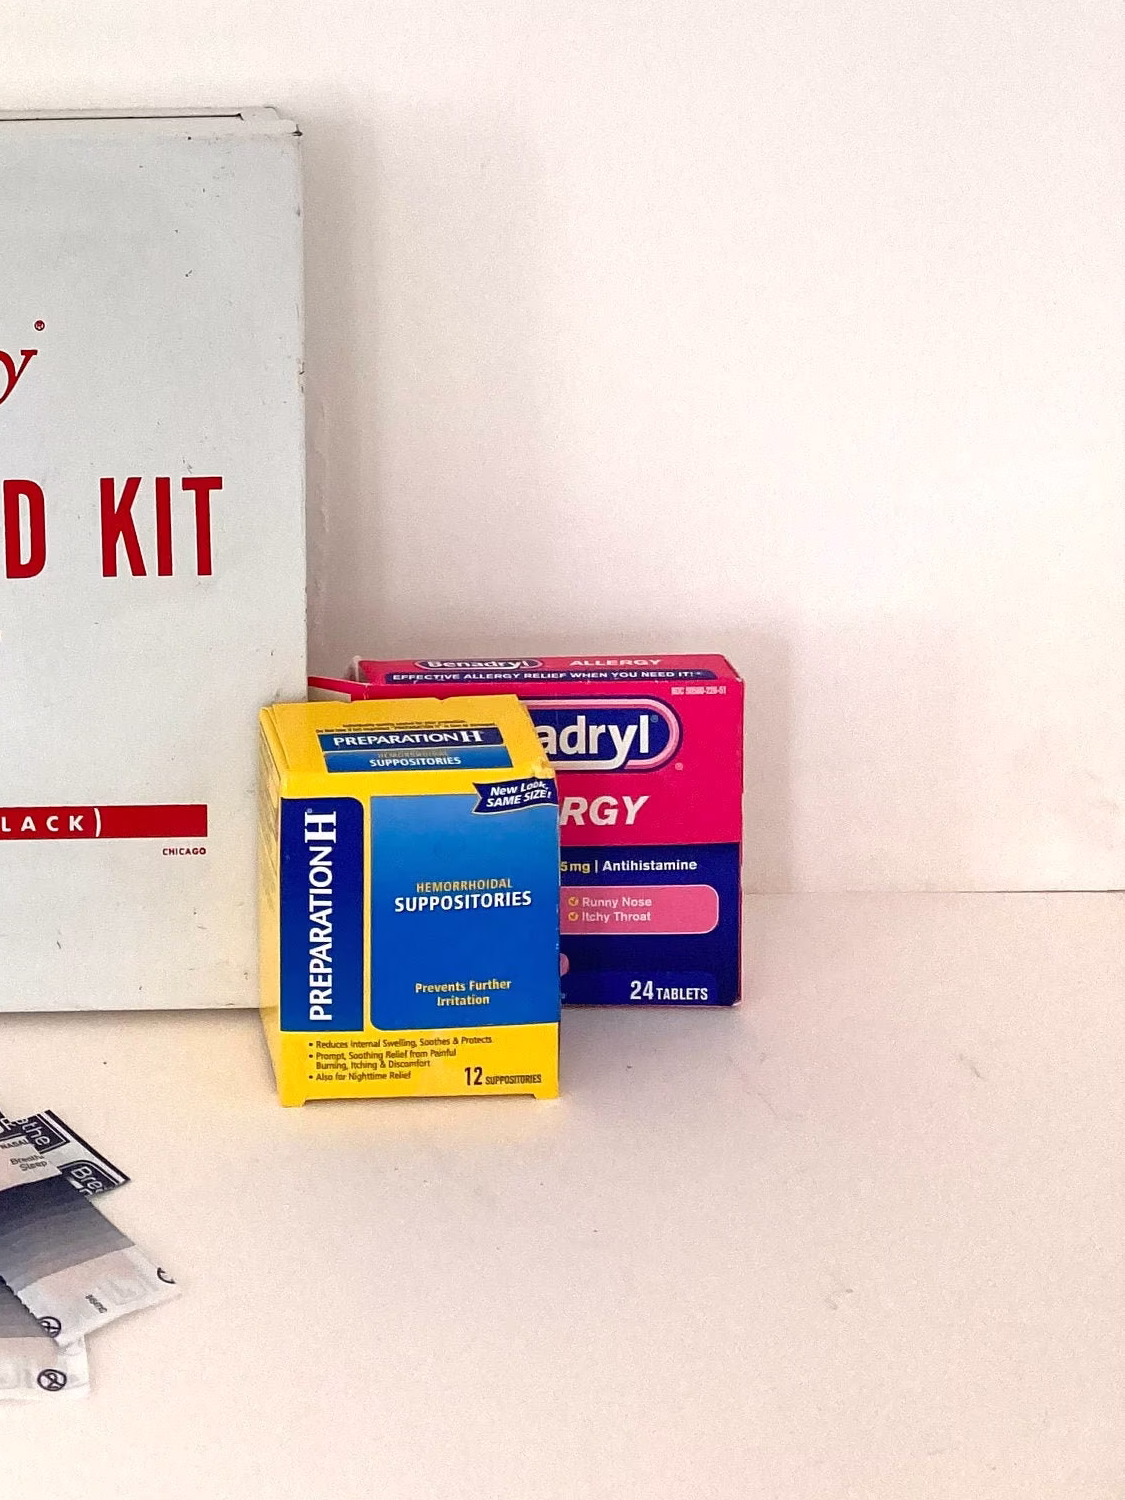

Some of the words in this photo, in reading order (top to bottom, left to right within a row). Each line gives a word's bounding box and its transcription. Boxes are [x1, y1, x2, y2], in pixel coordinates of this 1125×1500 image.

[99, 476, 223, 578] KIT
[427, 660, 530, 670] Benadryl
[569, 659, 662, 667] ALLERGY
[392, 673, 460, 681] EFFECTIVE
[463, 672, 520, 680] ALLERGY
[569, 671, 608, 679] WHEN
[369, 756, 462, 768] SUPPOSITORIES
[490, 785, 518, 797] New
[486, 795, 521, 808] SAME
[524, 788, 552, 803] SIZE!
[162, 847, 207, 856] CHICAGO
[602, 860, 698, 872] Antihistamine
[416, 878, 513, 893] HEMORRHOIDAL
[394, 890, 532, 913] SUPPOSITORIES
[582, 897, 618, 909] Runny
[622, 896, 652, 907] Nose
[582, 911, 610, 922] Itchy
[613, 911, 651, 921] Throat
[415, 981, 466, 994] Prevents
[469, 978, 512, 992] Further
[630, 980, 654, 1000] 24
[656, 987, 708, 1000] TABLETS
[436, 994, 490, 1006] Irritation
[316, 1040, 348, 1049] Reduces
[350, 1039, 381, 1048] Internal
[419, 1037, 450, 1047] Soothes
[461, 1036, 492, 1045] Protects
[348, 1050, 383, 1061] Soothing
[385, 1049, 408, 1059] Relief
[409, 1049, 428, 1058] from
[430, 1048, 457, 1058] Painful
[350, 1060, 378, 1070] Itching
[388, 1058, 431, 1068] Discomfort
[316, 1072, 333, 1081] Also
[335, 1072, 347, 1080] for
[348, 1071, 387, 1082] Nighttime
[389, 1071, 412, 1080] Relief
[464, 1066, 483, 1086] 12
[485, 1074, 542, 1086] SUPPOSITORIES
